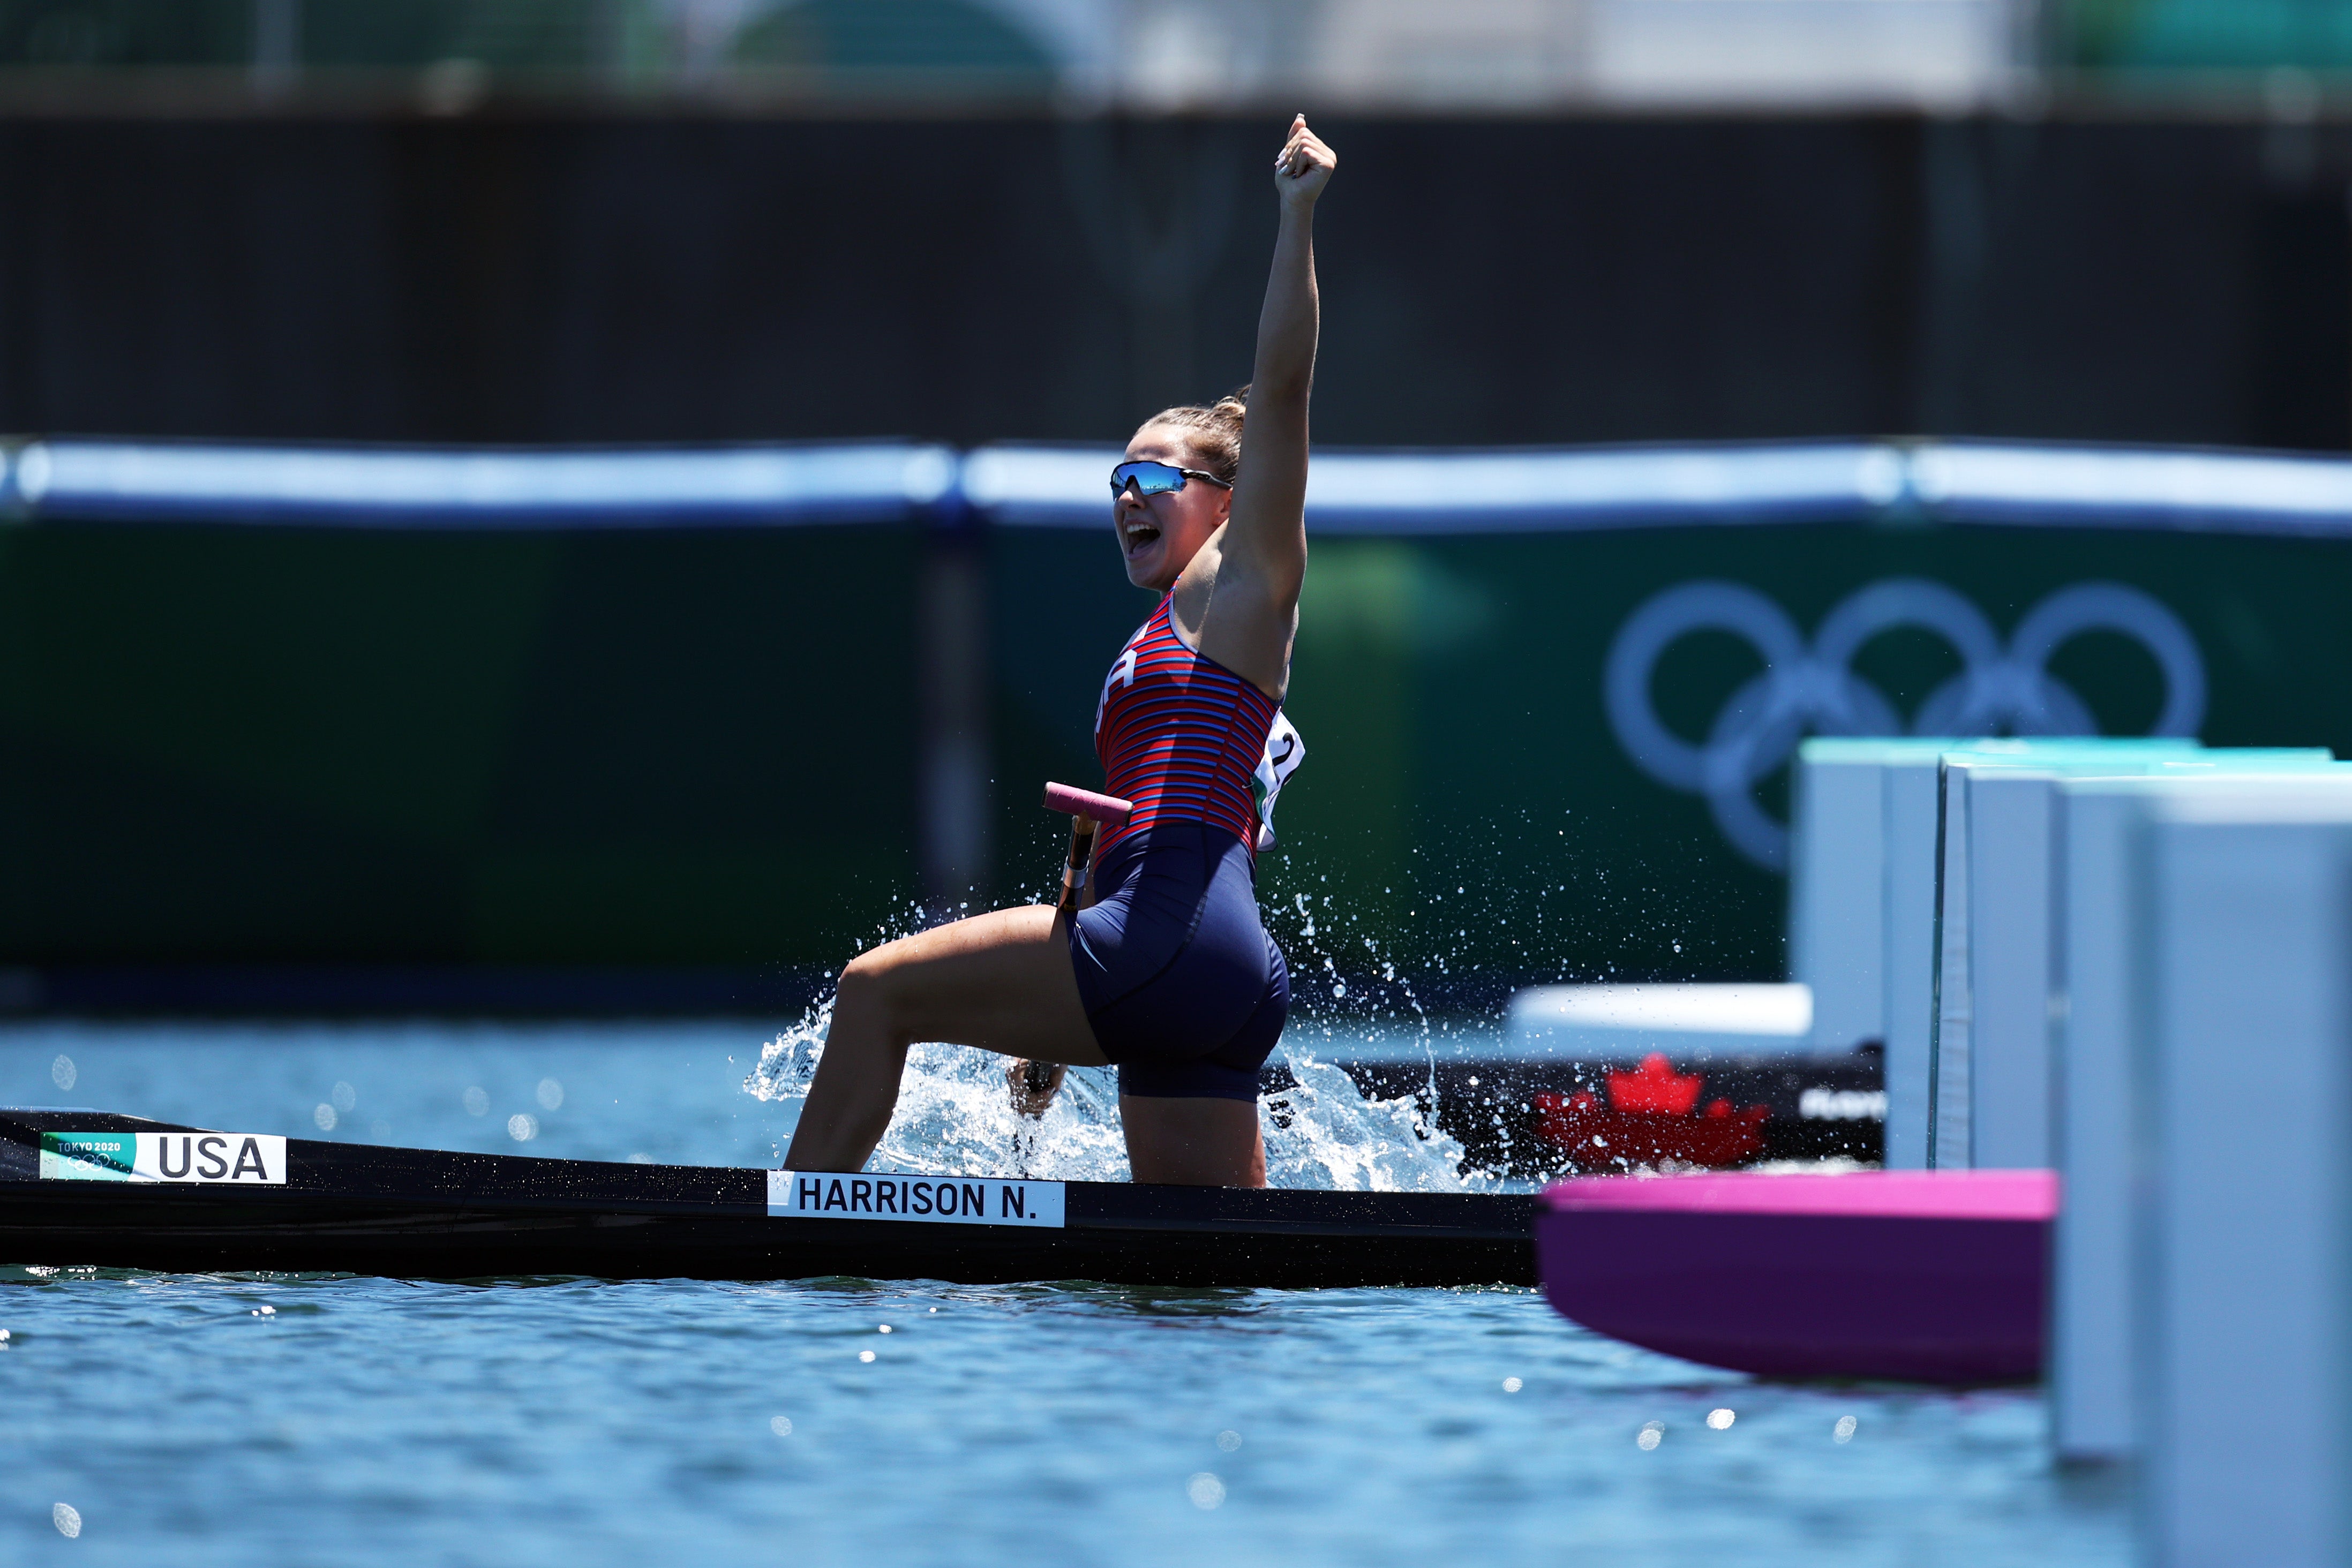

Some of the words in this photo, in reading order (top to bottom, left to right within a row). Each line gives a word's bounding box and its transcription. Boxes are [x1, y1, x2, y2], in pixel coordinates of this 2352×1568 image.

[58, 1142, 93, 1152] TOKYO
[94, 1142, 121, 1151] 2020
[159, 1136, 267, 1180] USA
[799, 1178, 984, 1217] HARRISON
[1002, 1186, 1036, 1218] N.
